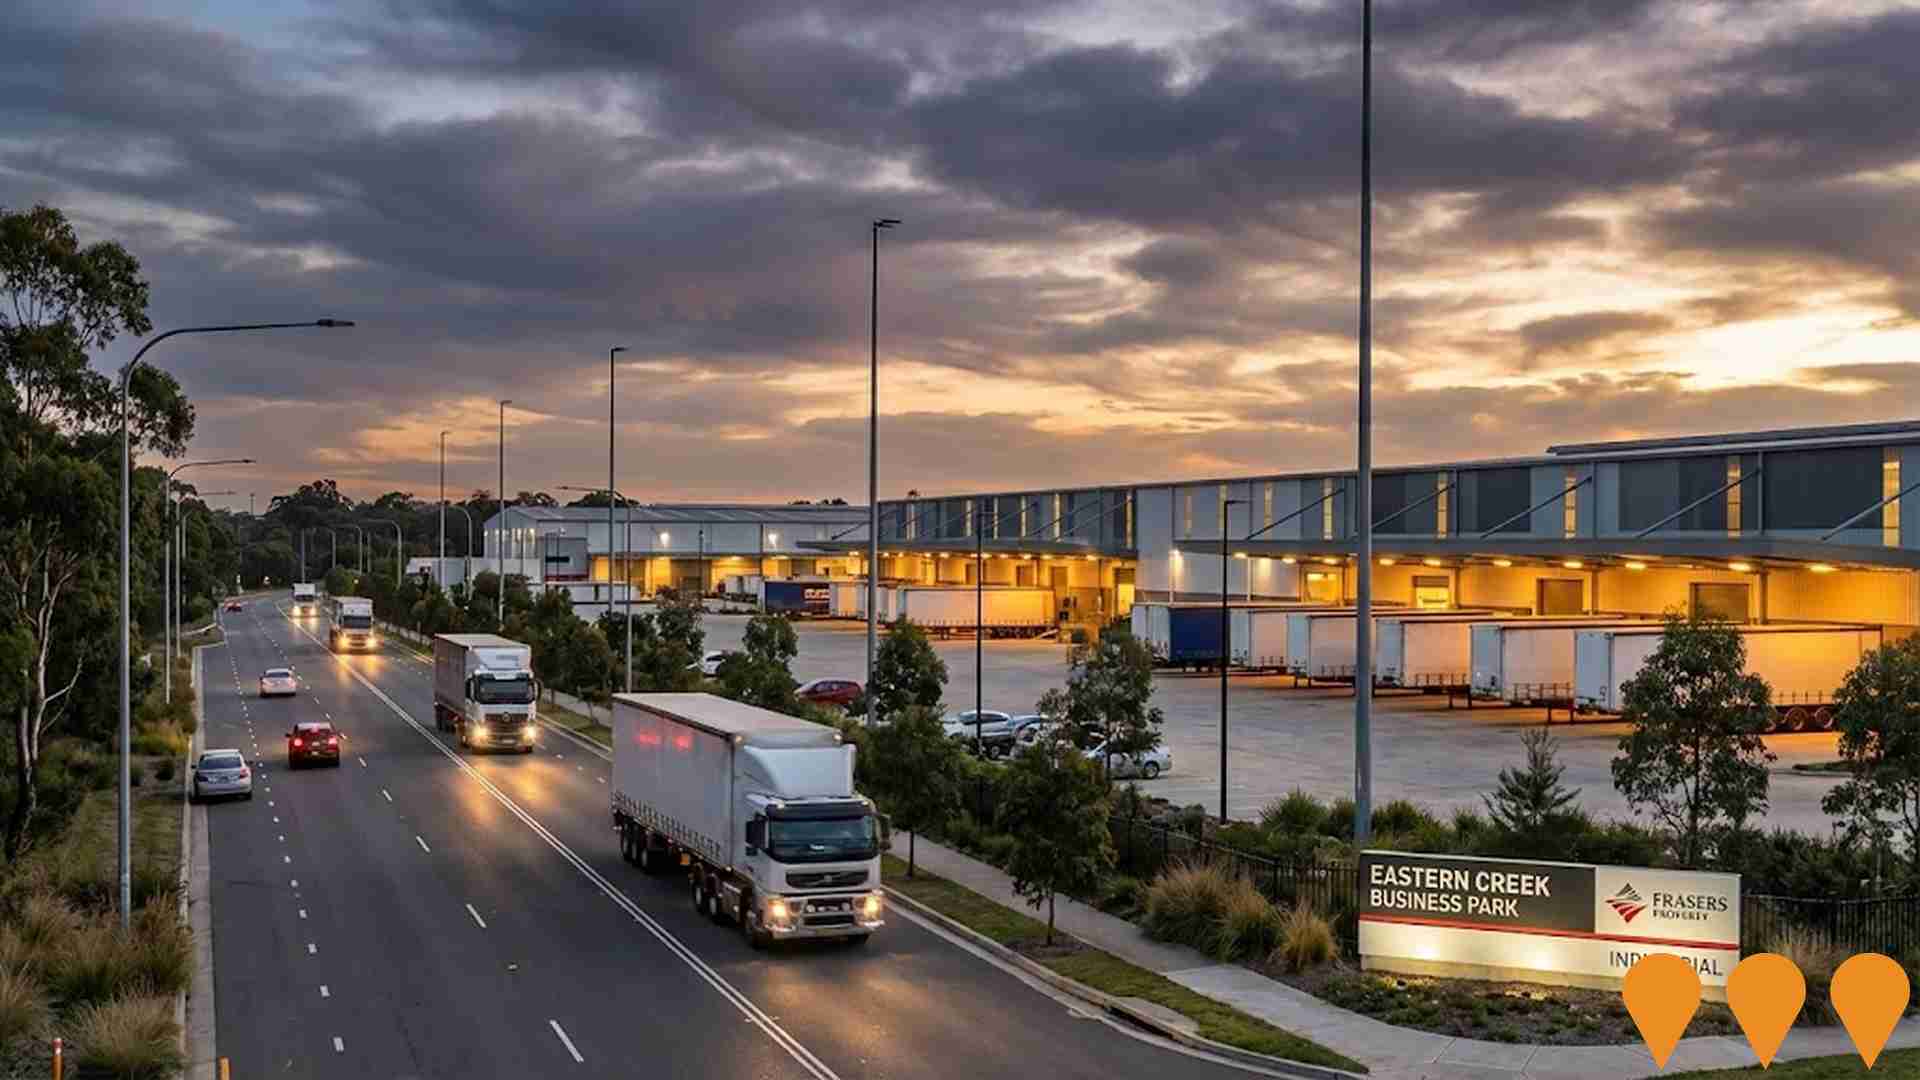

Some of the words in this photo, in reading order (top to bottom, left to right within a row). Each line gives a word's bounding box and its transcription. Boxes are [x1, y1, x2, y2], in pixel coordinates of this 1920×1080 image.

[1370, 864, 1470, 891] EASTERN
[1475, 871, 1552, 897] CREEK
[1370, 888, 1463, 912] BUSINESS
[1468, 895, 1520, 917] PARK
[1653, 892, 1729, 912] FRASERS
